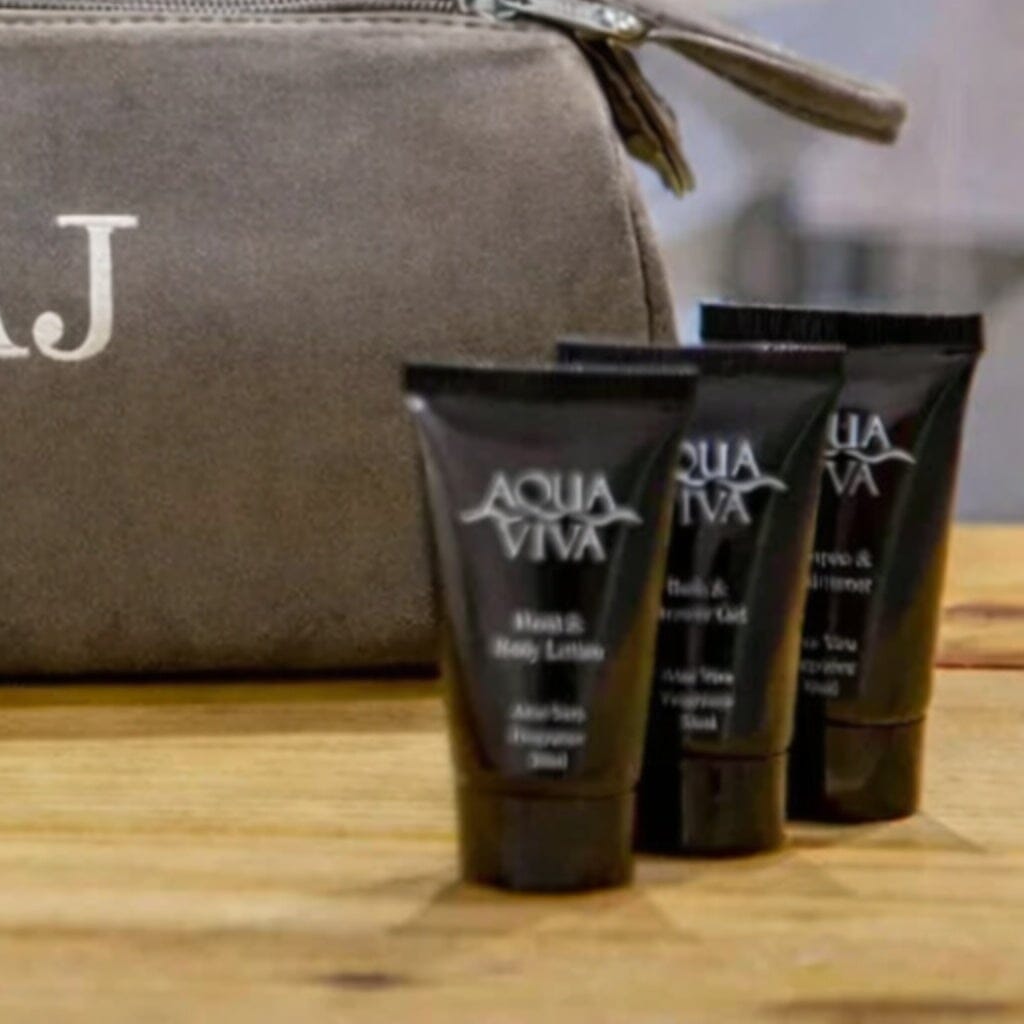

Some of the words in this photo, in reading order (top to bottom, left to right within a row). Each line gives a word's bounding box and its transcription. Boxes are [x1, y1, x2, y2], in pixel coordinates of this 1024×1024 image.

[826, 413, 893, 454] UA
[676, 440, 761, 484] QUA
[476, 472, 620, 522] AQUA
[679, 487, 752, 526] IVA
[495, 519, 607, 561] VIVA
